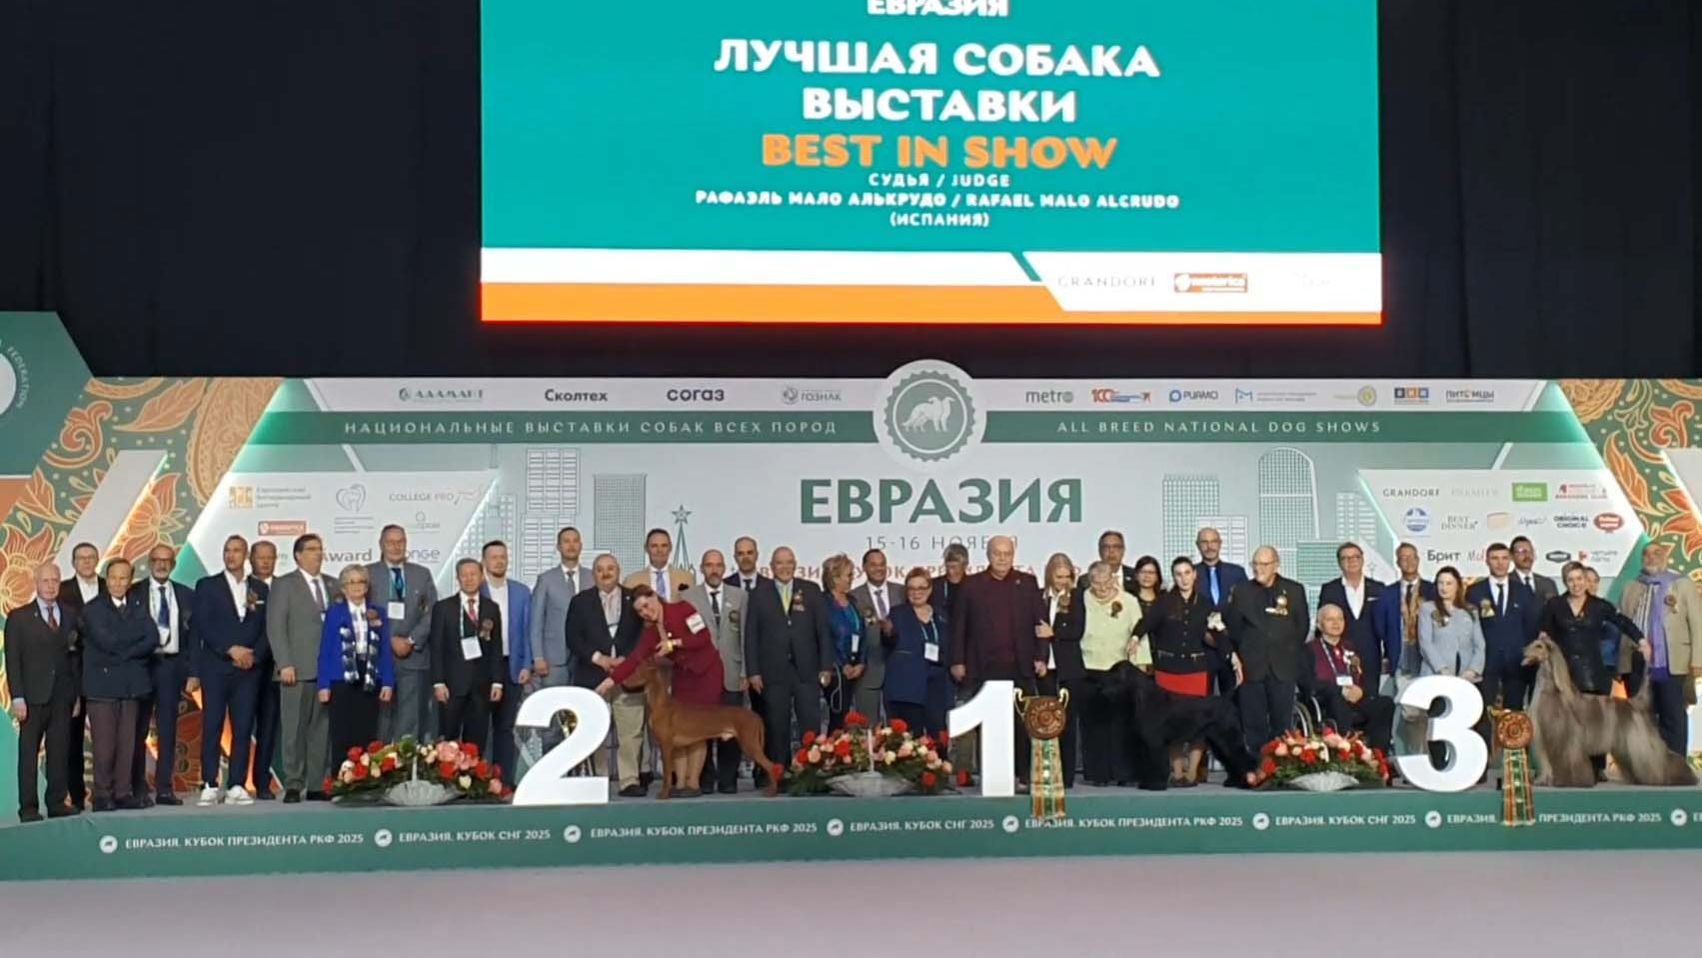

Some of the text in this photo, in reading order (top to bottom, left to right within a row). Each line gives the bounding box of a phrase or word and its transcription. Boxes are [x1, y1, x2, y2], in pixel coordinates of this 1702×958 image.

[714, 38, 1161, 78] ЛУЧШАЯ СОБАКА
[802, 87, 1077, 123] ВЫСТАВКИ
[762, 134, 1118, 169] BEST IN SHOW
[868, 172, 930, 188] СУДЬЯ
[951, 174, 1011, 188] JUDGE
[695, 190, 783, 206] РАФАЭЛЬ
[788, 191, 843, 206] МАЛО
[848, 192, 947, 209] АЛЬКРУДО
[966, 194, 1035, 208] RAFAEL
[1040, 194, 1091, 209] MALO
[1097, 194, 1180, 210] ALCRUDO
[890, 211, 990, 228] (ИСПАНИЯ)
[544, 387, 608, 403] Сколтех
[666, 388, 726, 402] согаз
[1025, 388, 1075, 404] metro
[344, 421, 837, 434] НАЦИОНАЛЬНЫЕ ВЫСТАВКИ СОБАК ВСЕХ ПОРОД
[1057, 421, 1381, 434] ALL BREED NATIONAL DOG SHOWS
[800, 478, 1082, 524] ЕВРАЗИЯ
[867, 536, 921, 550] 15-16
[1427, 549, 1461, 564] Брит
[948, 681, 1017, 796] 1
[1397, 675, 1489, 792] 3
[513, 687, 612, 807] 2
[903, 820, 943, 832] КУБОК
[943, 820, 968, 831] СНГ
[969, 819, 995, 830] 2025
[1077, 818, 1116, 829] КУБОК
[1117, 817, 1192, 830] ПРЕЗИДЕНТА
[1193, 817, 1218, 828] РКФ
[1218, 816, 1244, 827] 2025
[1328, 816, 1366, 826] КУБОК
[1367, 816, 1391, 826] СНГ
[1391, 815, 1417, 825] 2025
[1538, 813, 1611, 824] ПРЕЗИДЕНТА
[1612, 813, 1636, 824] РКФ
[1637, 813, 1663, 823] 2025
[456, 830, 498, 841] КУБОК
[498, 830, 523, 840] СНГ
[525, 829, 552, 840] 2025
[646, 826, 687, 837] КУБОК
[687, 825, 764, 837] ПРЕЗИДЕНТА
[765, 824, 790, 835] РКФ
[792, 823, 818, 834] 2025
[183, 837, 226, 848] КУБОК
[226, 835, 308, 848] ПРЕЗИДЕНТА
[309, 834, 336, 845] РКФ
[337, 833, 364, 844] 2025
